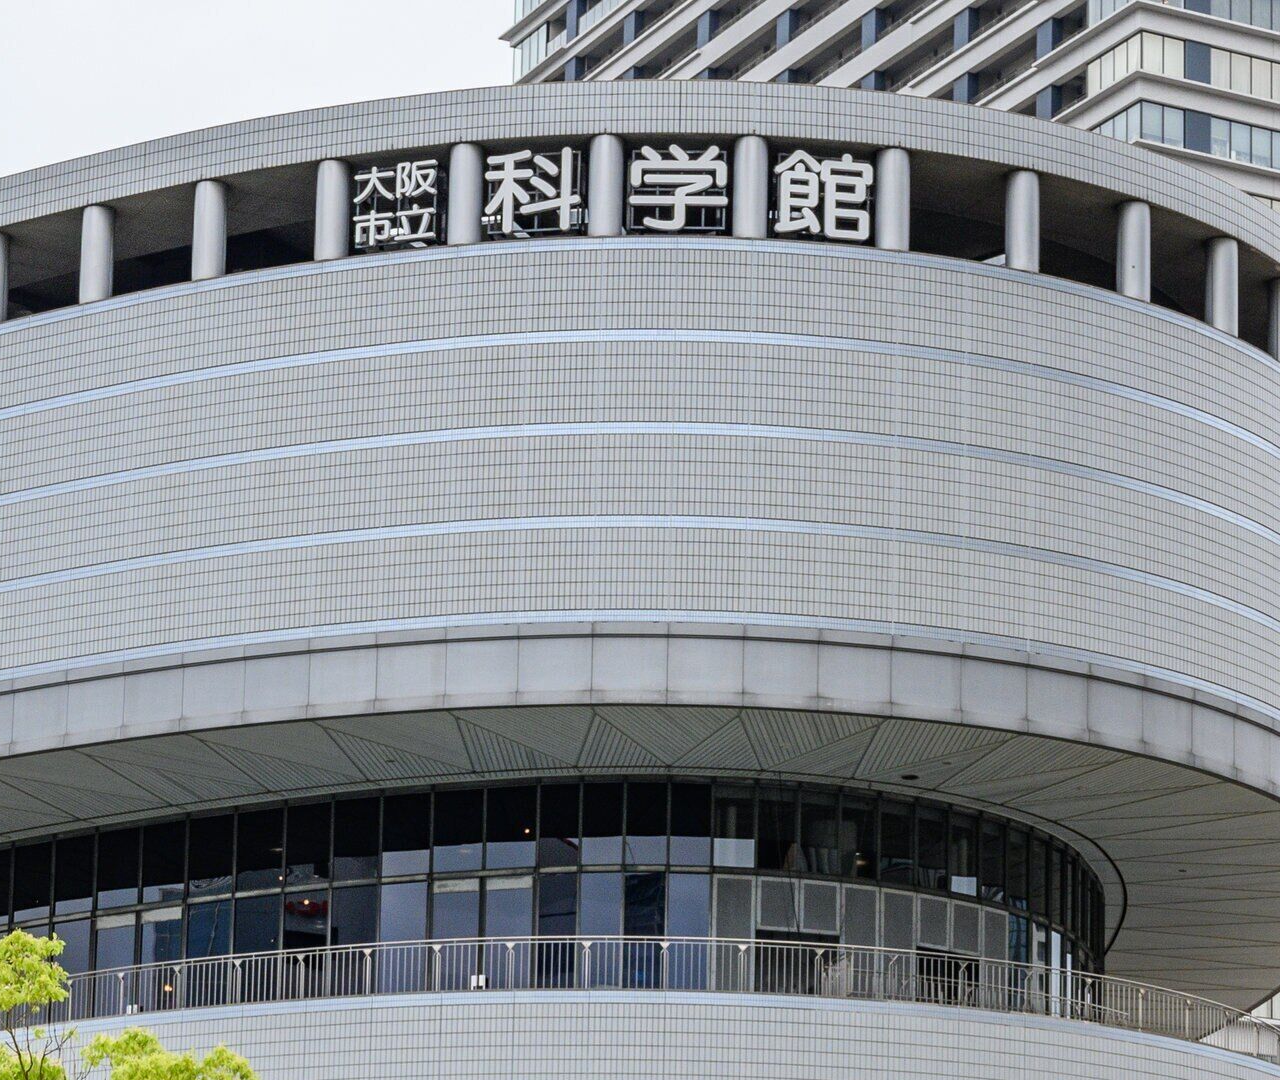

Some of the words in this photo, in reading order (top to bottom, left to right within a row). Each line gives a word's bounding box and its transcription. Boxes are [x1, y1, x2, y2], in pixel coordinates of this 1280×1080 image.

[353, 158, 439, 204] 大阪
[485, 144, 874, 242] 科学館
[353, 205, 436, 247] 市立
